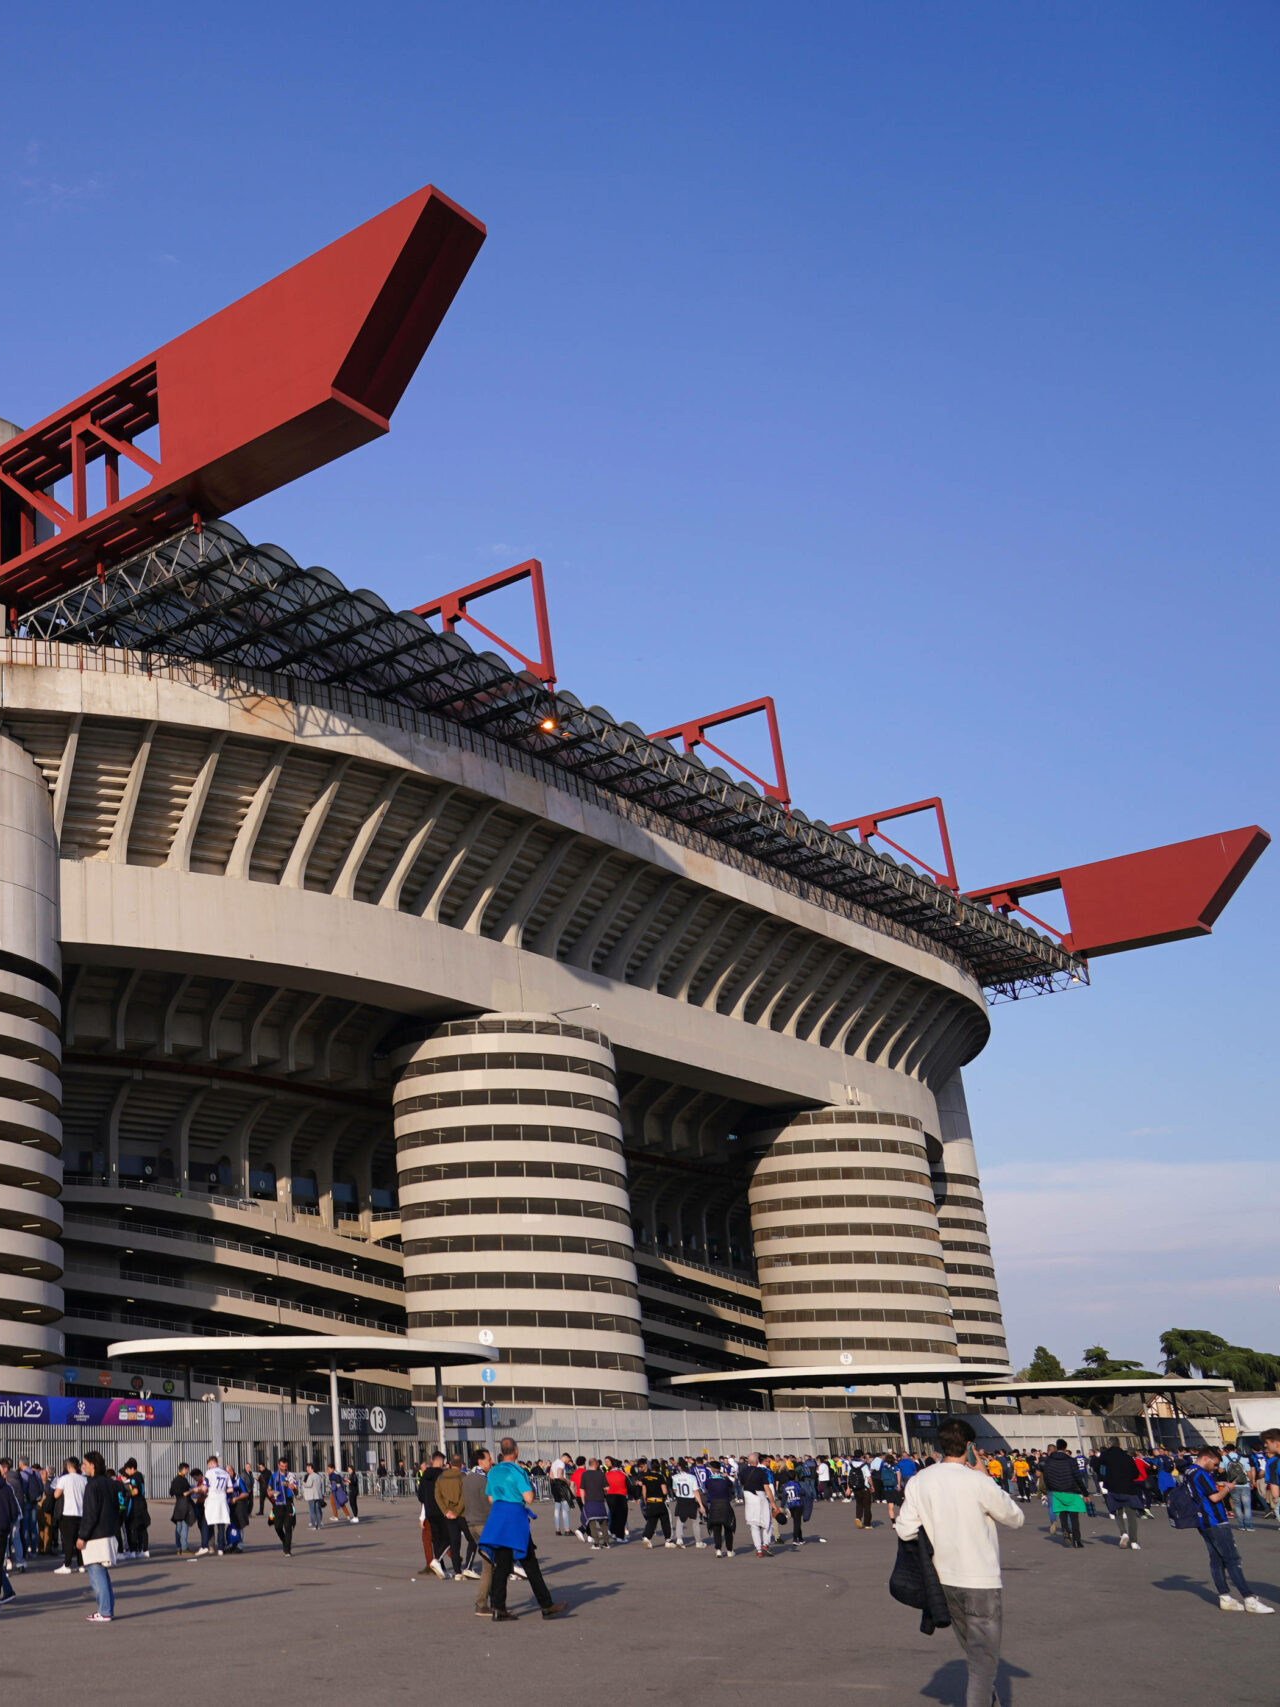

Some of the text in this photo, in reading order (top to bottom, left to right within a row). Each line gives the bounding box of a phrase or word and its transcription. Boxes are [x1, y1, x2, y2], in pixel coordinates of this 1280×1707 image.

[341, 1407, 369, 1420] INGRESSO
[373, 1410, 384, 1429] 13
[216, 1476, 226, 1489] 77
[677, 1483, 690, 1496] 10
